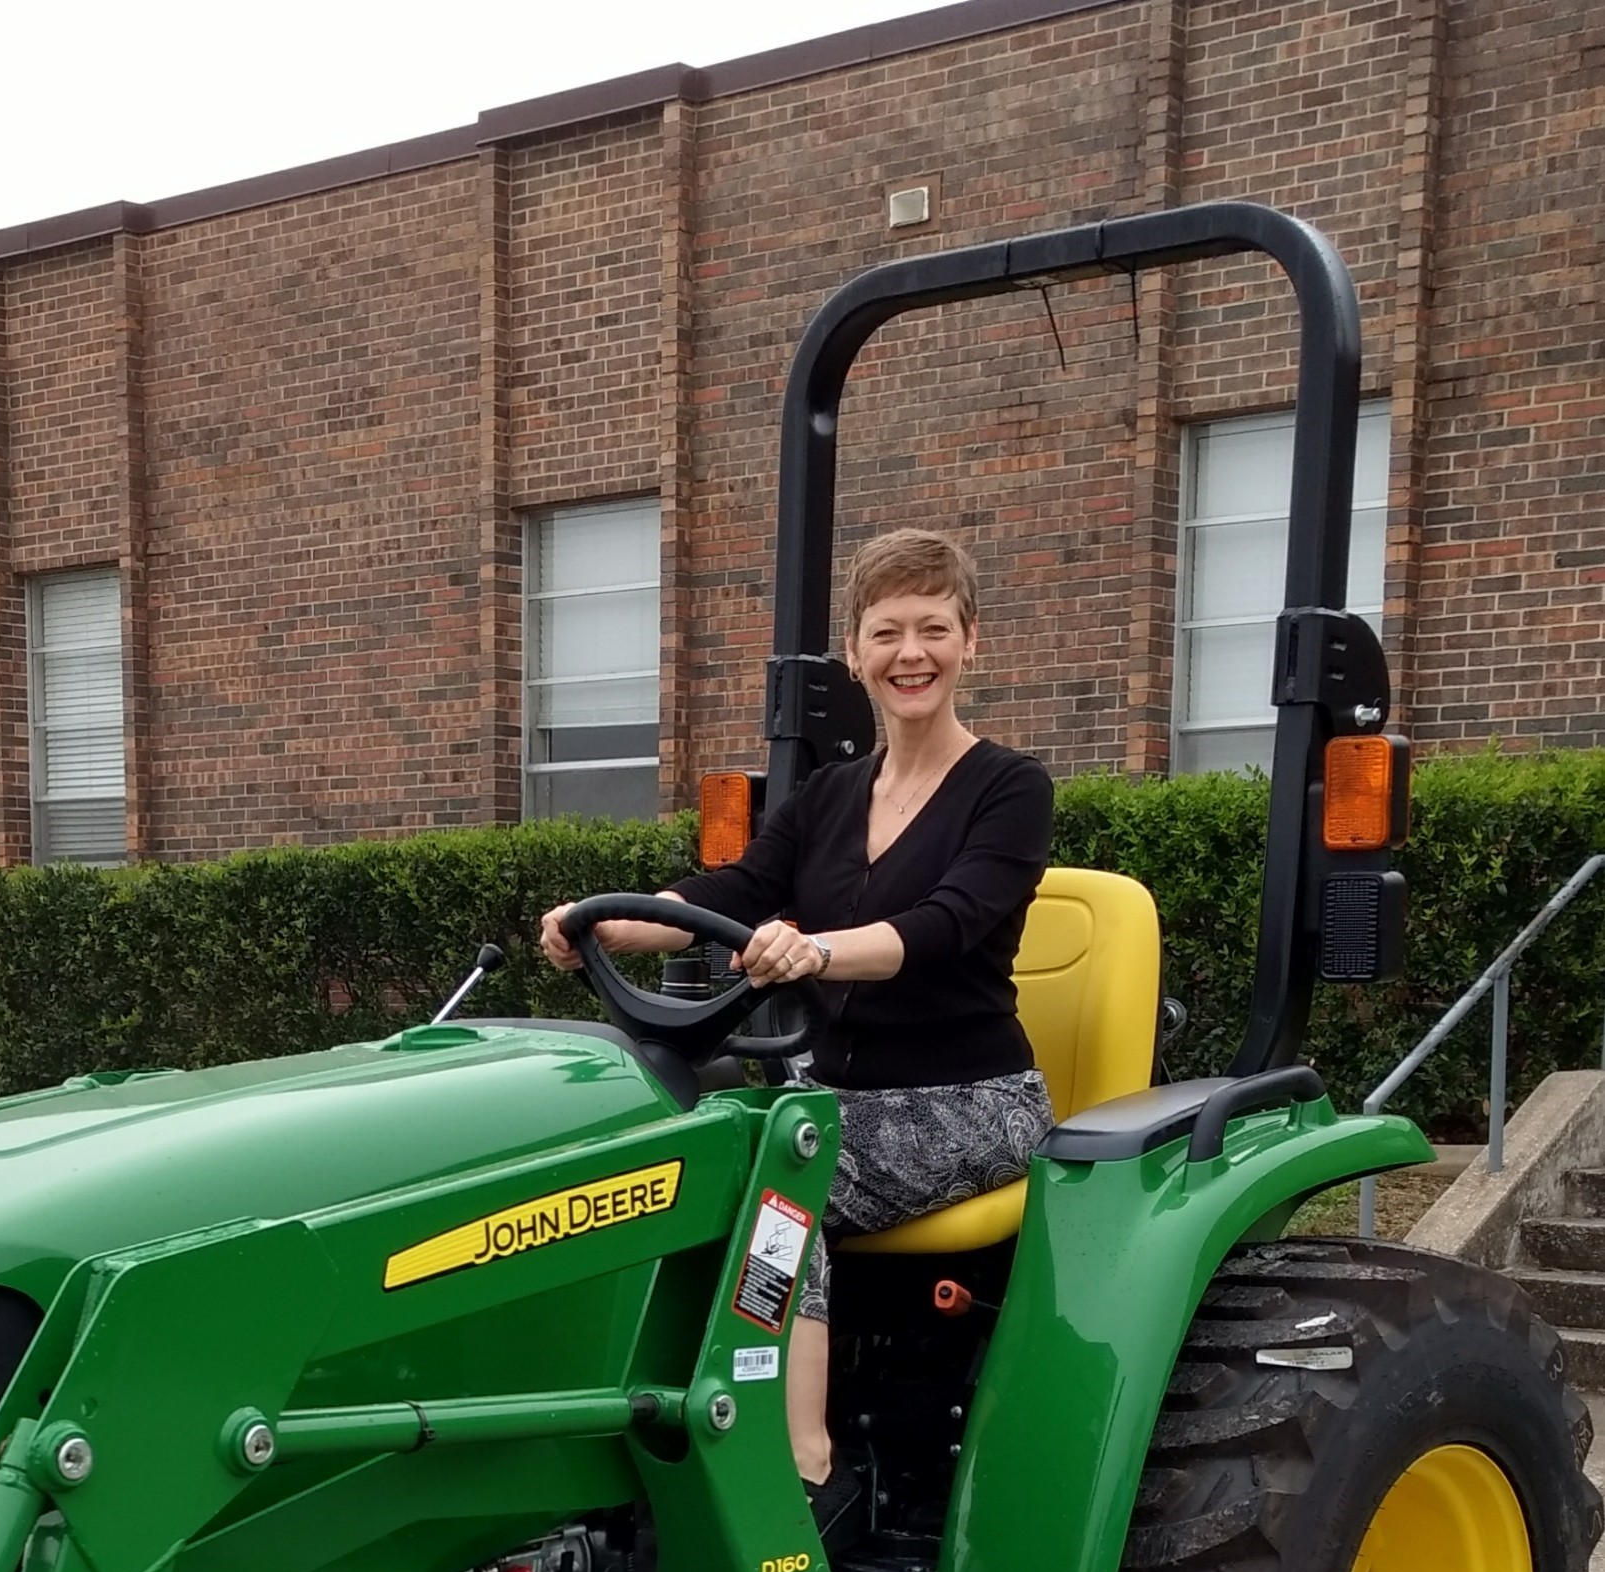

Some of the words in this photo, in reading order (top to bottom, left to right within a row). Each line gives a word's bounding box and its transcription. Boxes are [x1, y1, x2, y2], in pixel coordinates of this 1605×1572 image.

[474, 1207, 560, 1260] JOHN
[568, 1177, 667, 1230] DEERE
[778, 1202, 806, 1224] DANGER
